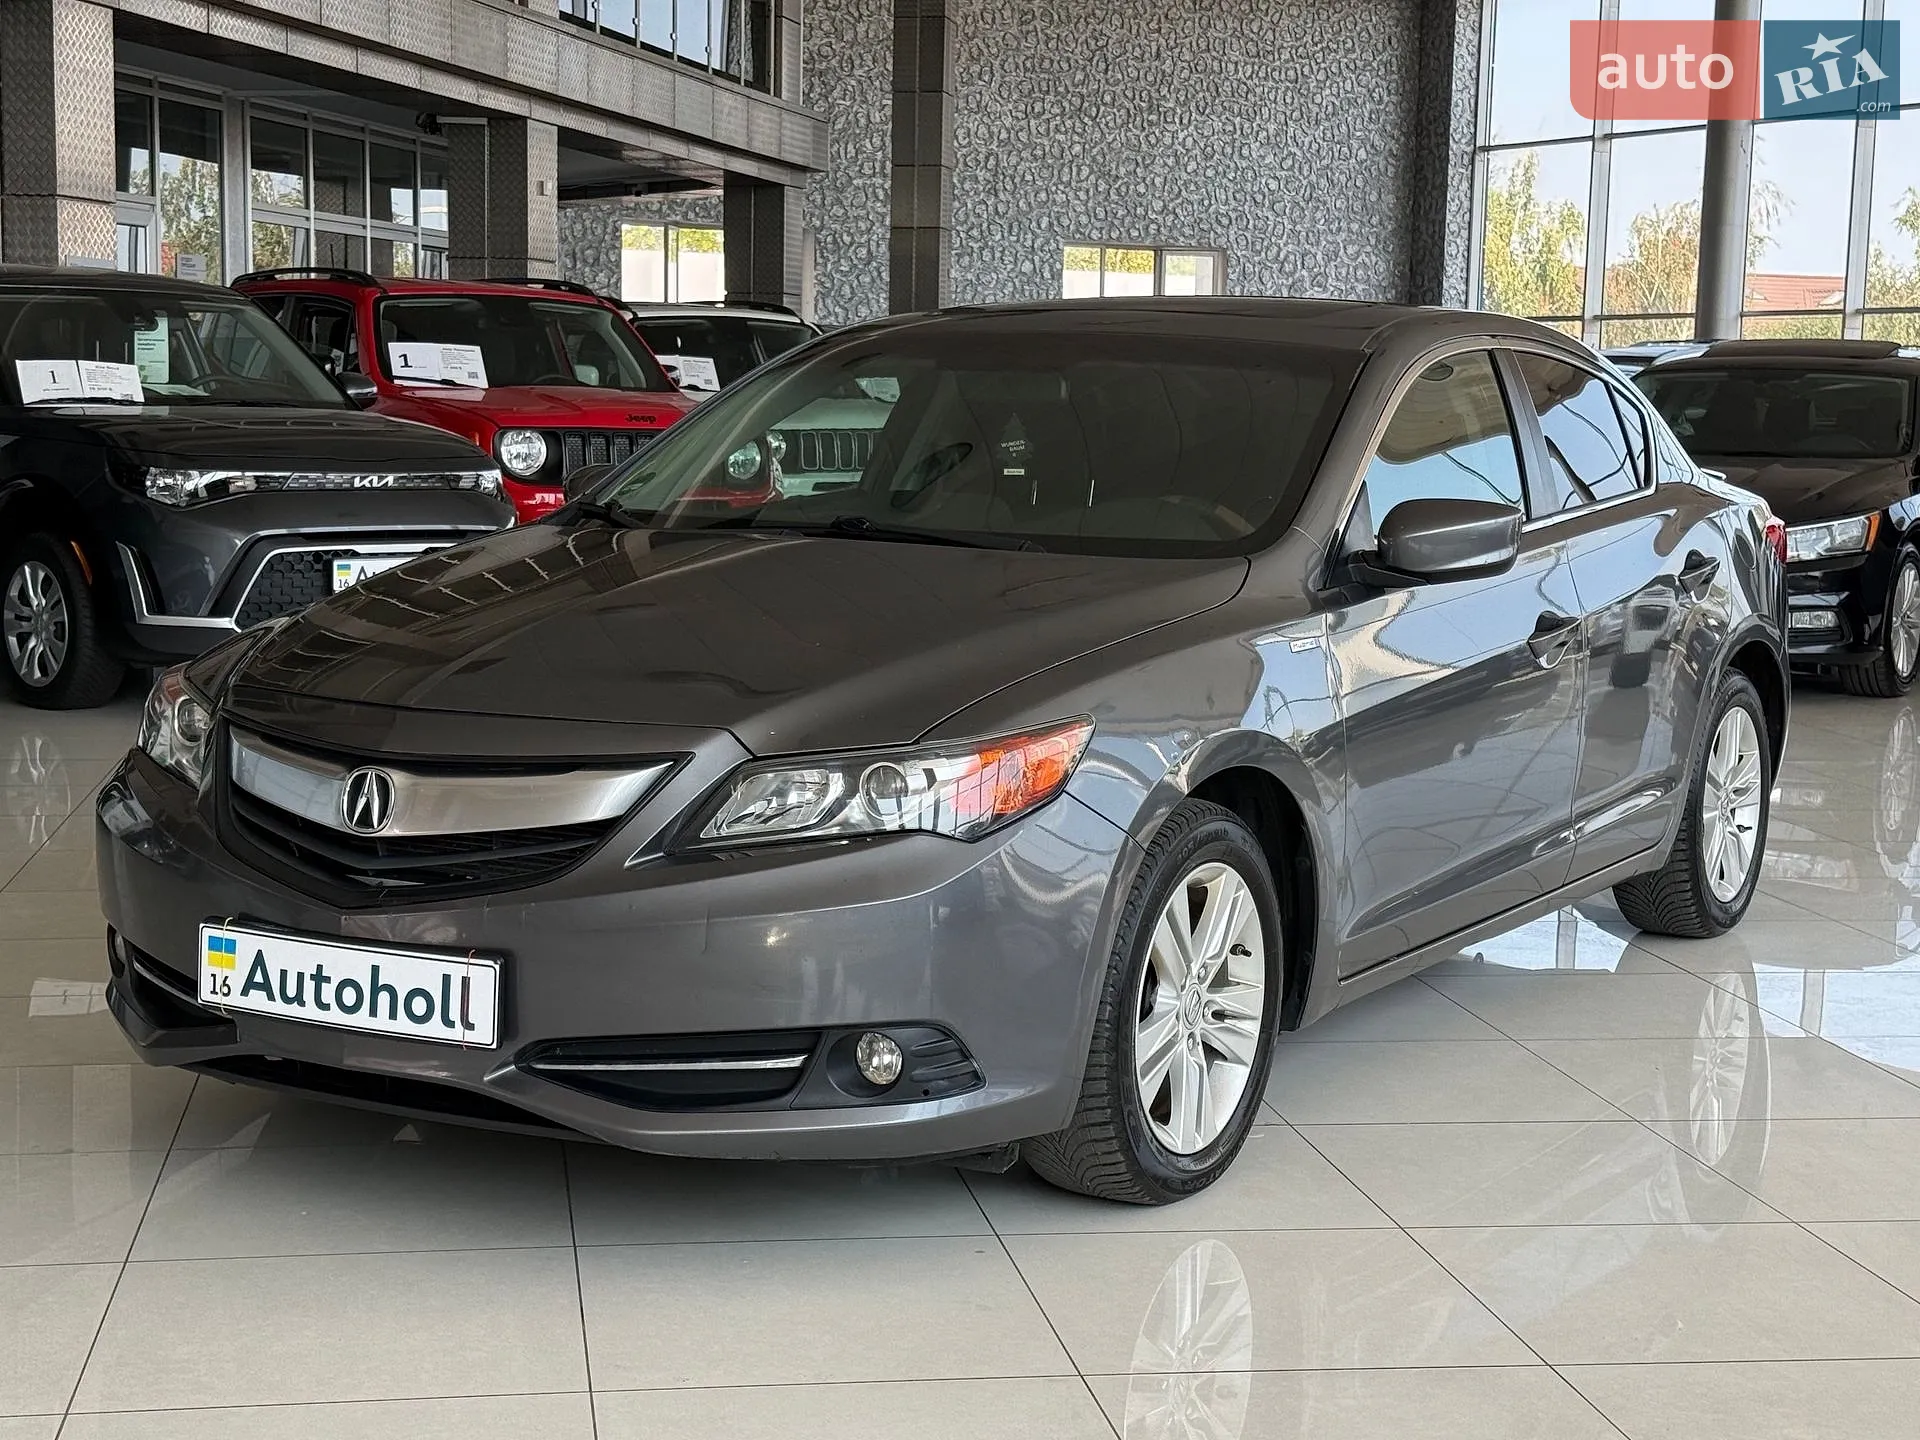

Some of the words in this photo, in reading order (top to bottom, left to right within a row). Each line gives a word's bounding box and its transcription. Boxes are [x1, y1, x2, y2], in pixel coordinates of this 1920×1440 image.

[398, 353, 413, 369] 1
[48, 369, 60, 385] 1
[625, 413, 657, 424] Jeep
[353, 475, 394, 488] KIA
[209, 972, 232, 998] 16
[240, 949, 476, 1032] Autoholl
